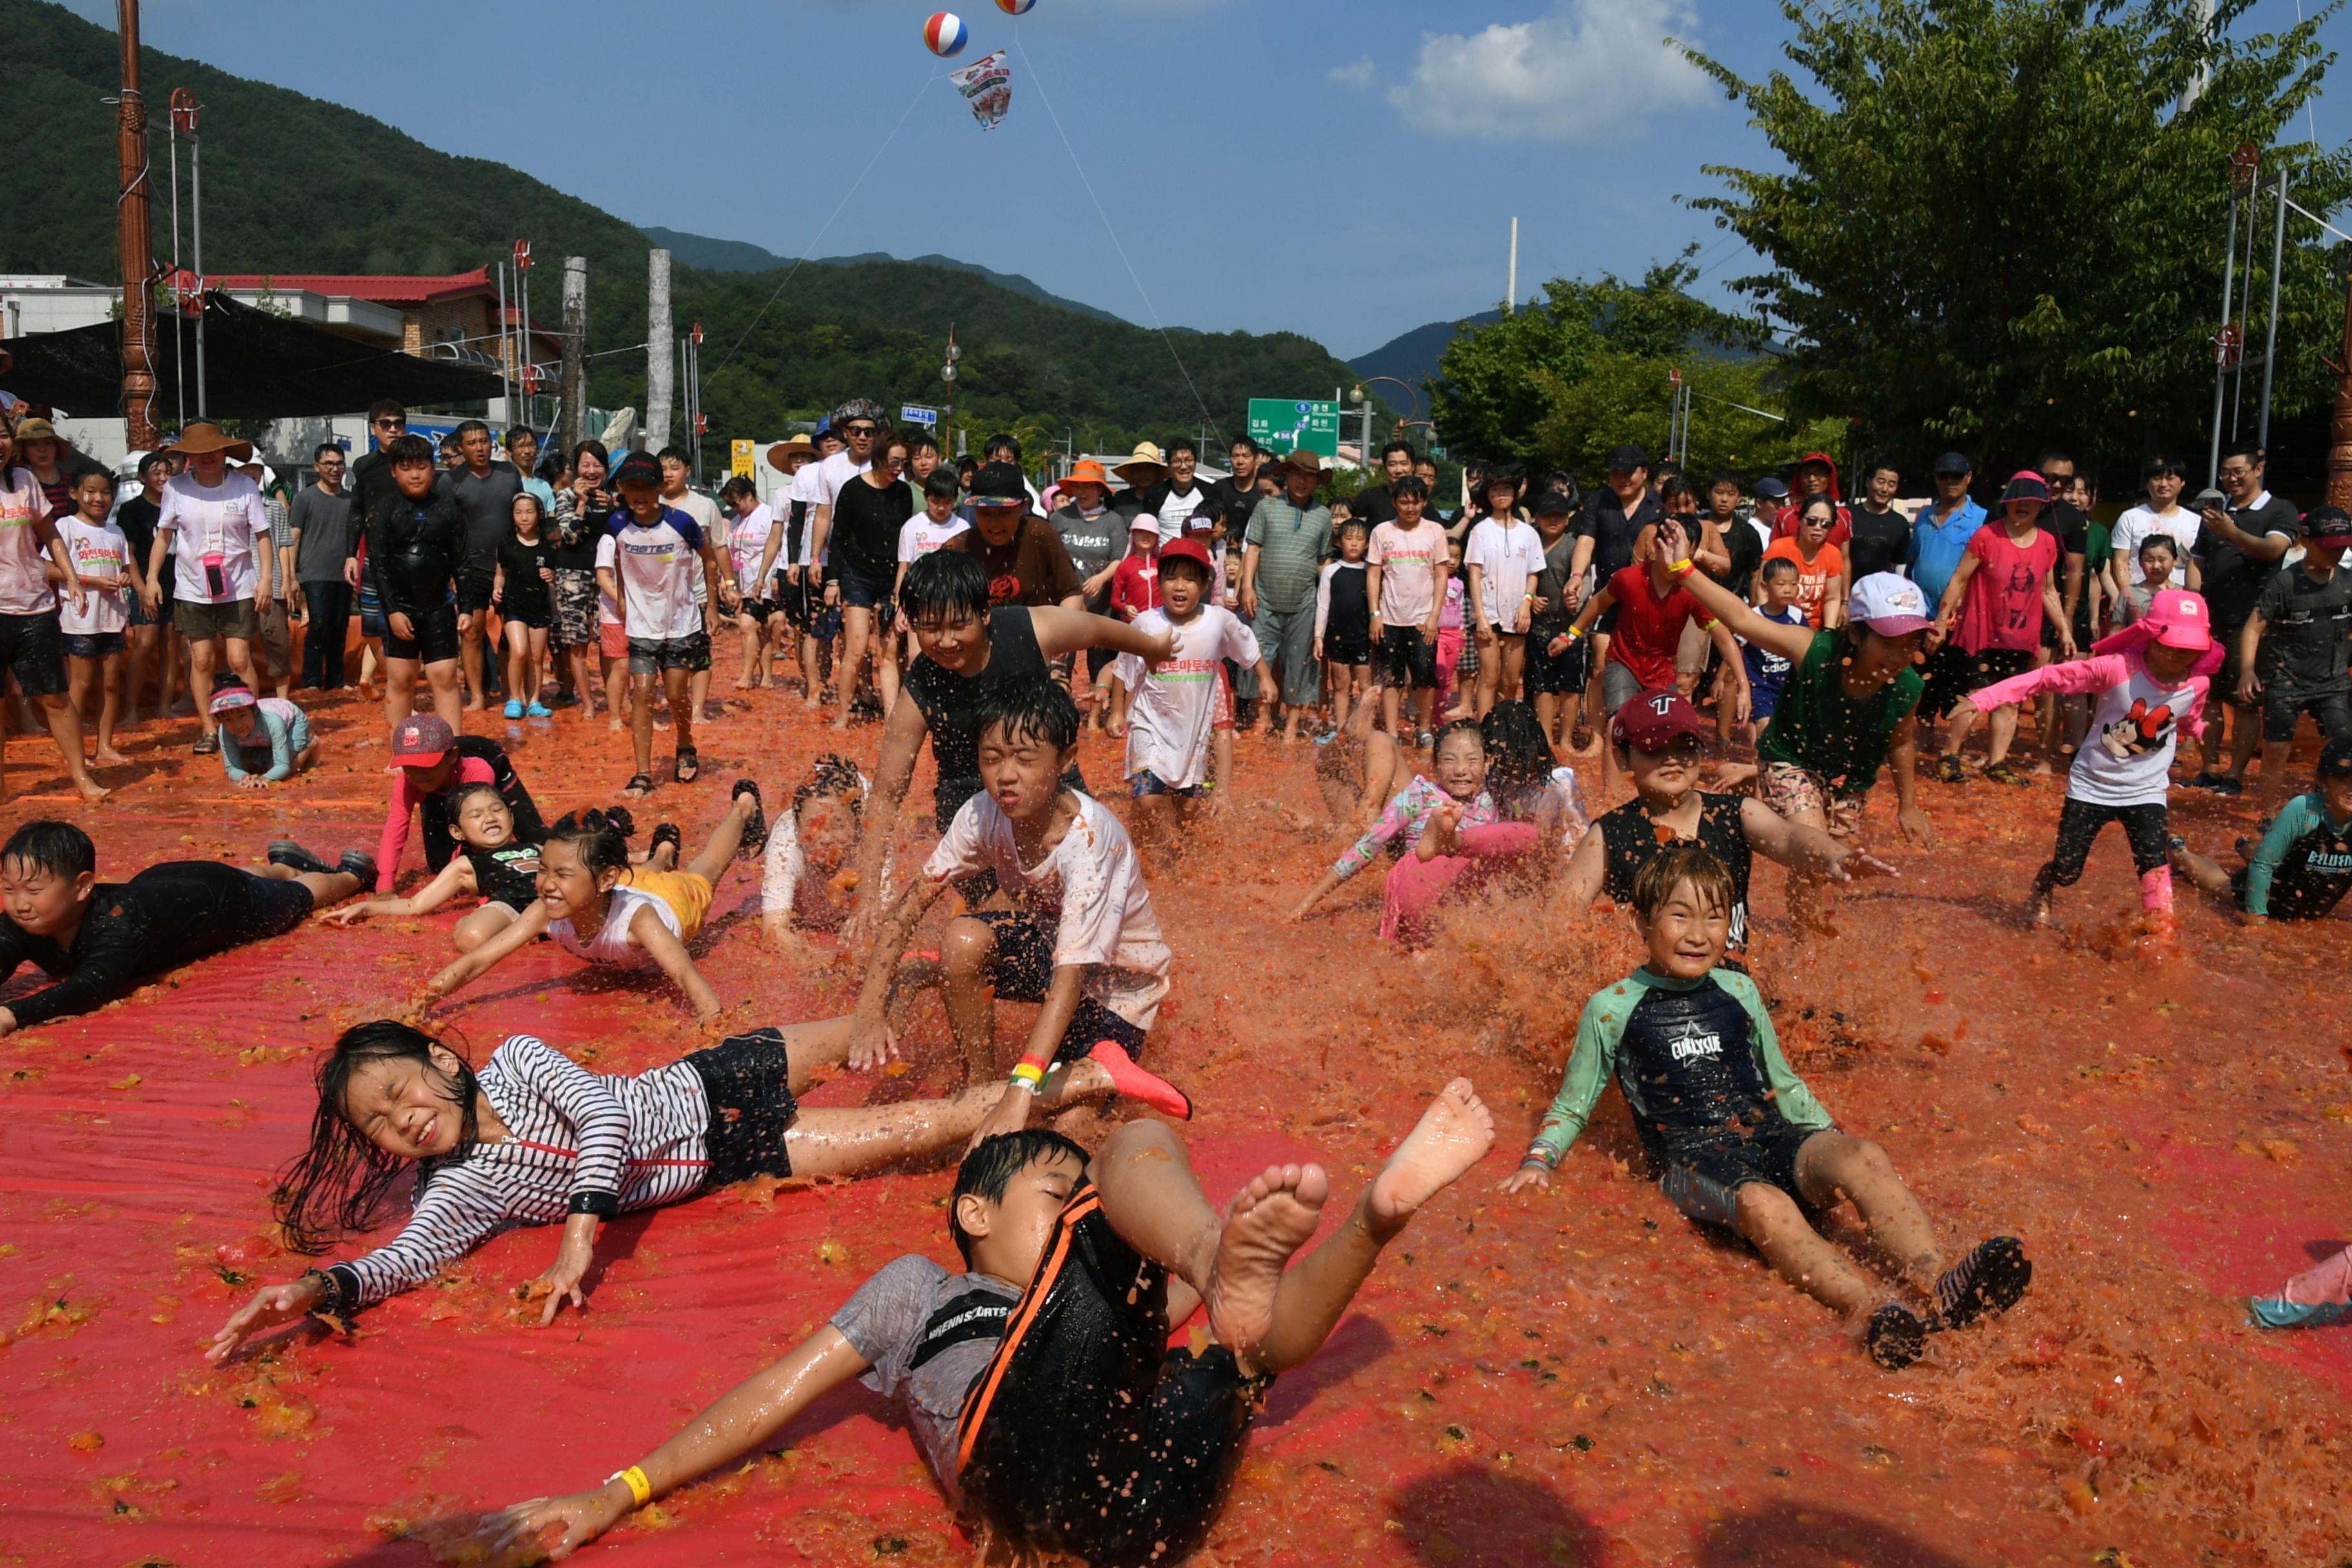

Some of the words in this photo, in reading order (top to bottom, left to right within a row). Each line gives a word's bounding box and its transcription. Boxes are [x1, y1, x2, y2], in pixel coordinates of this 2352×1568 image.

[624, 543, 674, 554] FASTER
[1648, 694, 1677, 716] T
[1671, 1035, 1723, 1060] CURLYSUE
